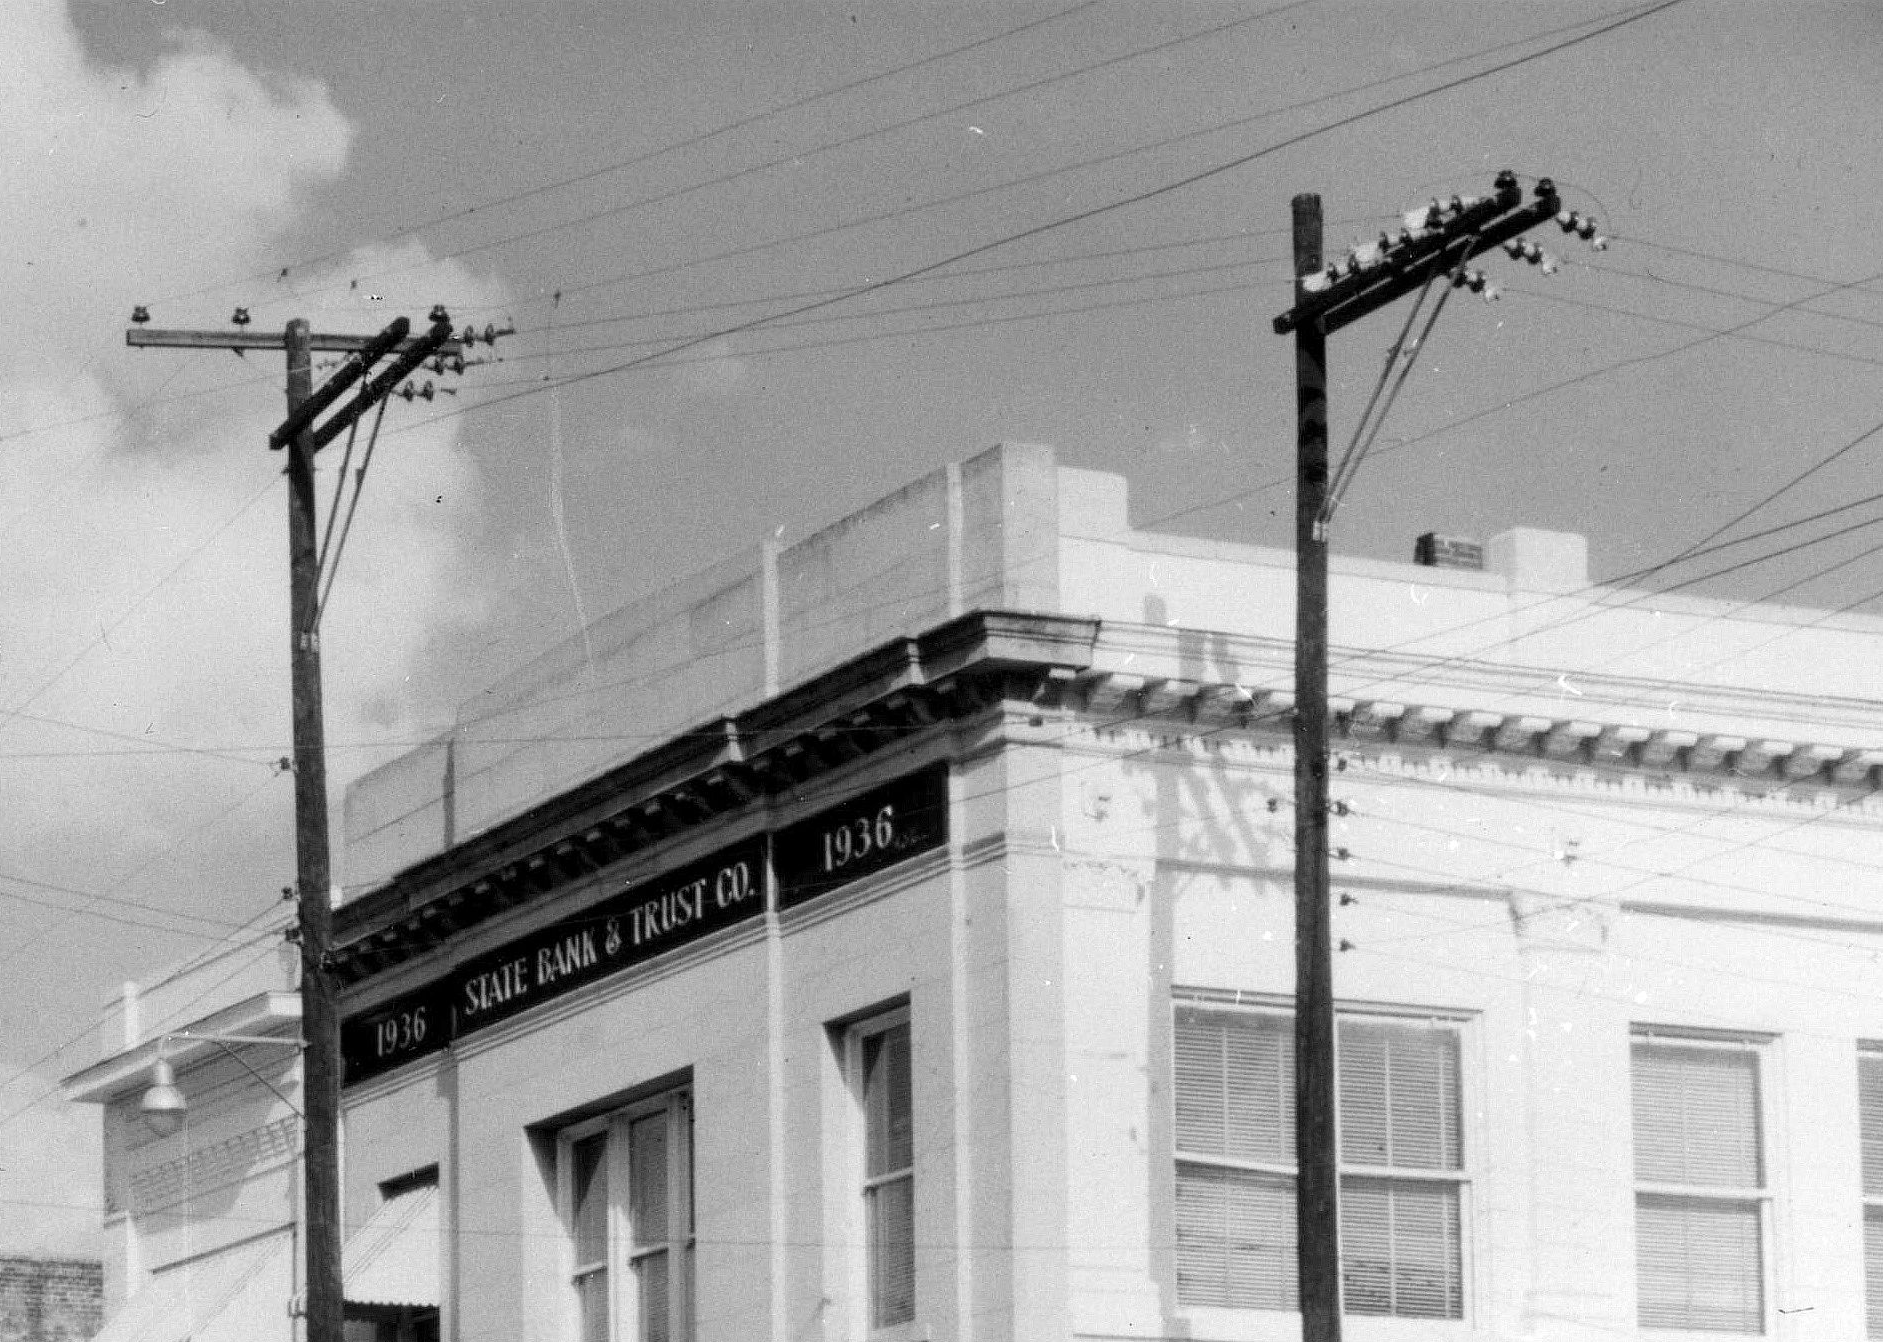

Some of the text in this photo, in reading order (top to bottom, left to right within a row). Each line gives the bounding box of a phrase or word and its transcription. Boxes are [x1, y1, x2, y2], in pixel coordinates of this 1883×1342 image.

[821, 806, 895, 872] 1936
[463, 862, 756, 1016] STATE BANK & TRUST CO.
[375, 1005, 427, 1058] 1936
